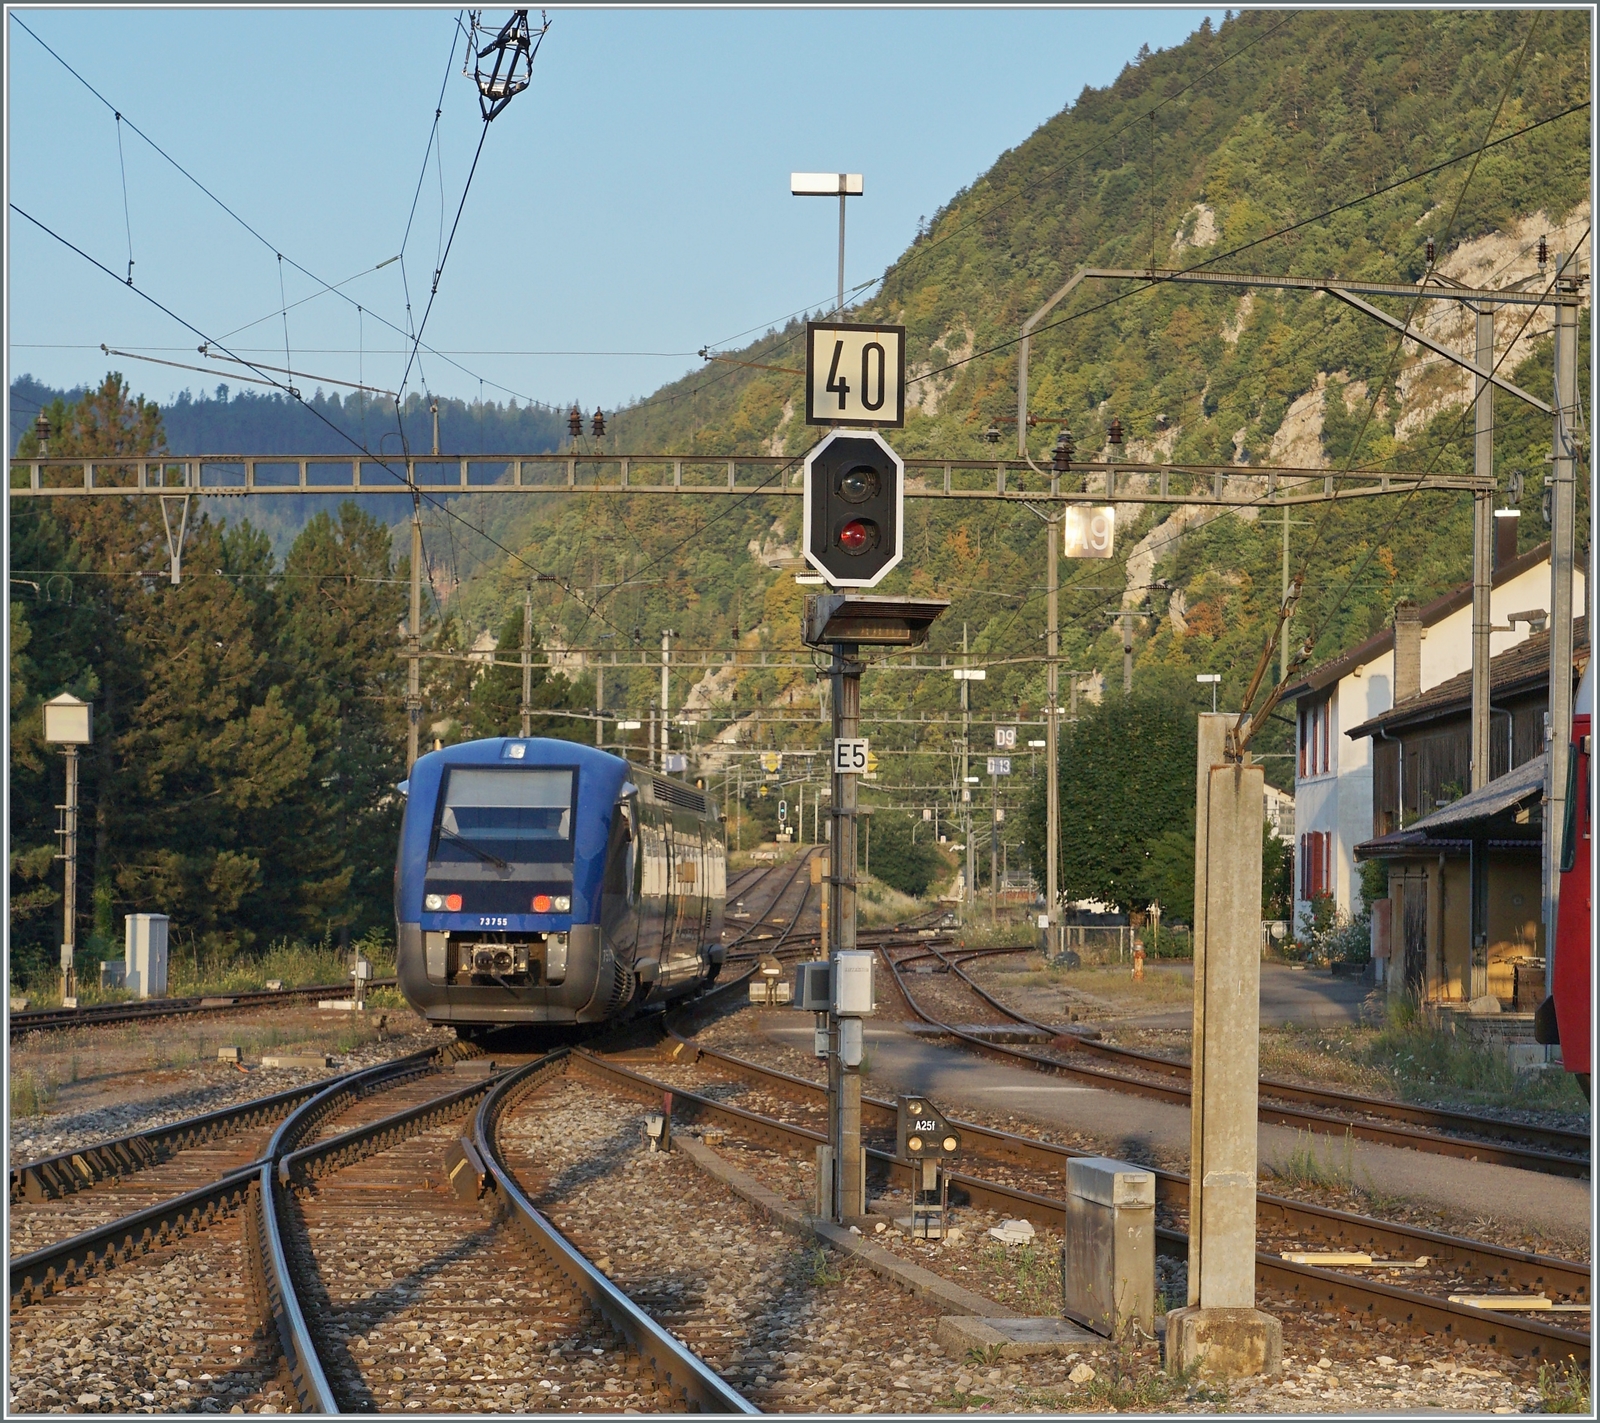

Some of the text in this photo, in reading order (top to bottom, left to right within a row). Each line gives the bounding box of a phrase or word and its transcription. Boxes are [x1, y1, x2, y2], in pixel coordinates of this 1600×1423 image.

[826, 340, 886, 411] 40
[1069, 513, 1109, 551] A9
[996, 729, 1015, 747] D9
[837, 743, 866, 769] E5
[987, 759, 1011, 774] D 13
[479, 917, 508, 927] 73755
[915, 1120, 936, 1132] A25f
